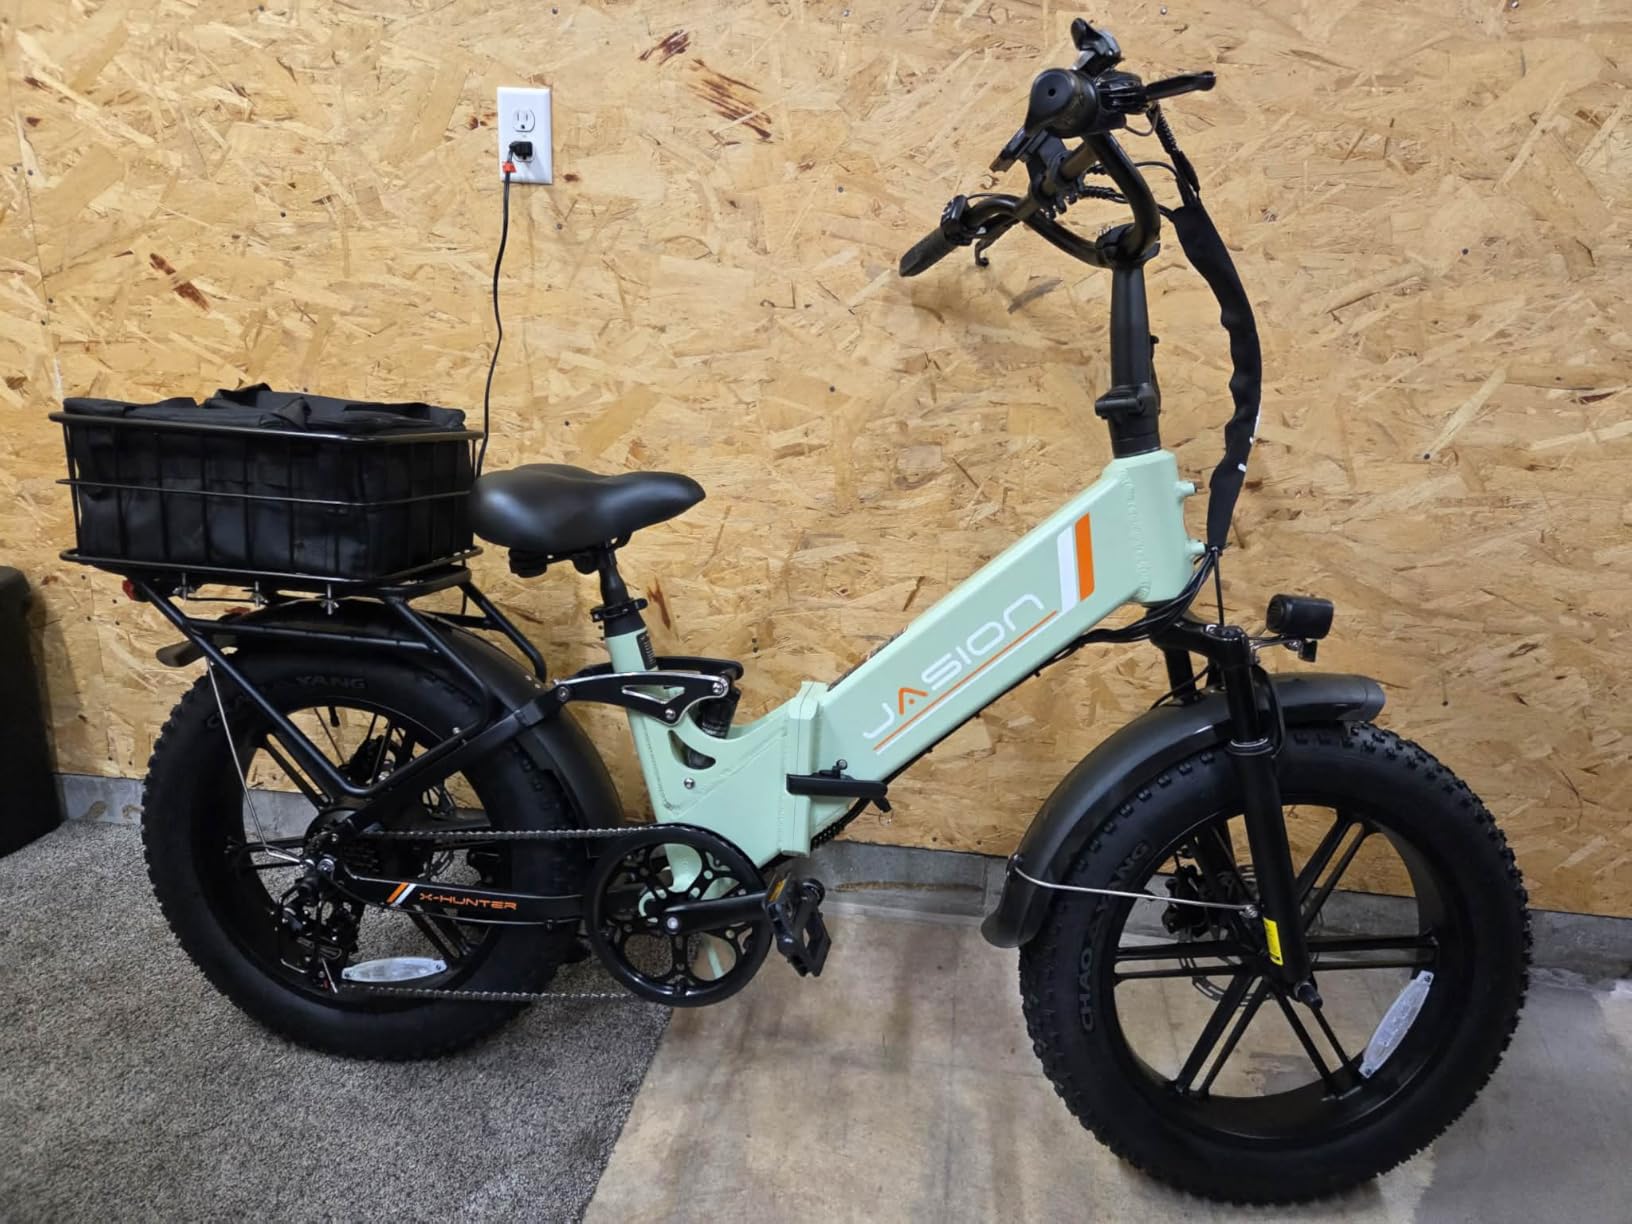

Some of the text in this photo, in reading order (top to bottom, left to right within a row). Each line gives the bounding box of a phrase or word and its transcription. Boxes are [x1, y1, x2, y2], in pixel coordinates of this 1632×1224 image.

[295, 674, 367, 689] YANG
[863, 594, 1045, 740] JASION
[420, 892, 518, 911] X-HUNTER
[1079, 947, 1095, 1033] CHAO
